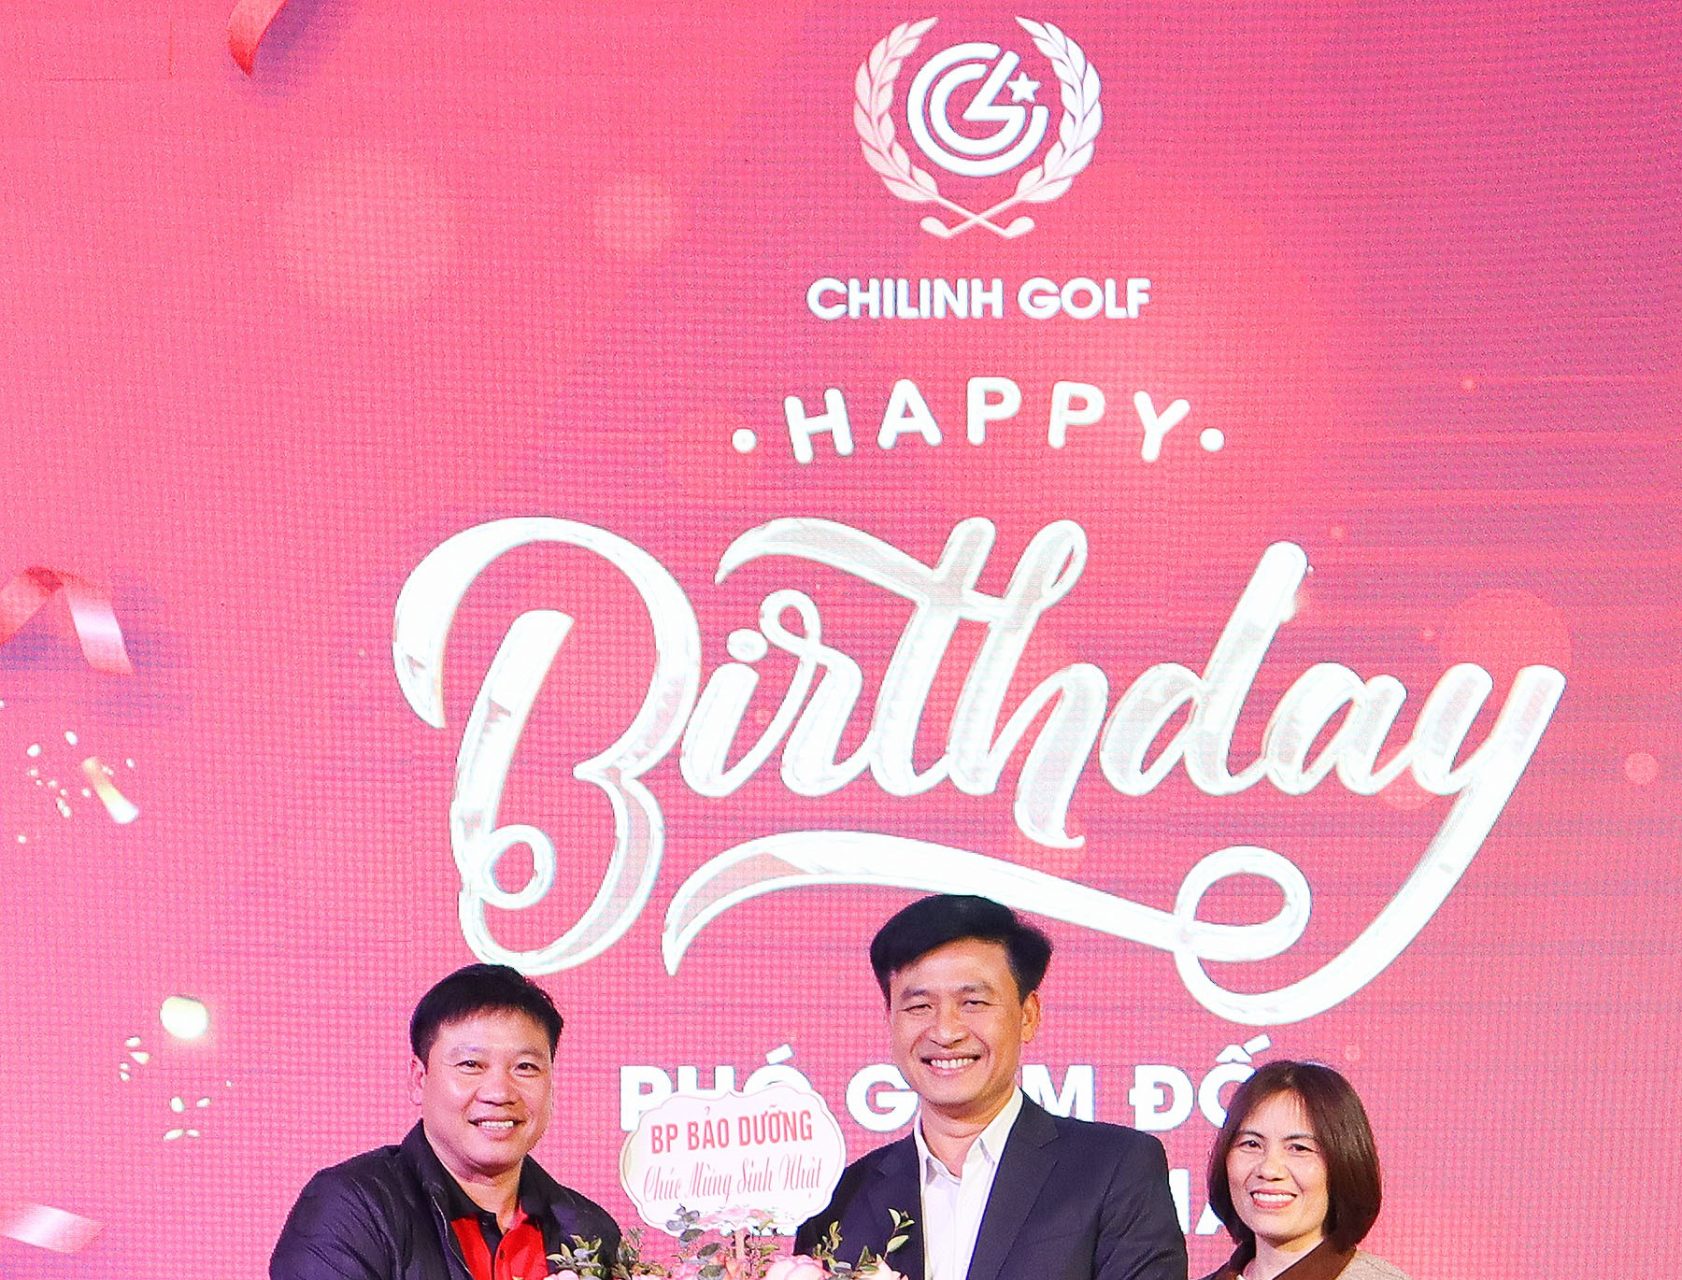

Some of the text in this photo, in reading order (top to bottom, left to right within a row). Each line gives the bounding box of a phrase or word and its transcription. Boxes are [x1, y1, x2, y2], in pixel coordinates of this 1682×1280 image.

[806, 276, 1152, 320] CHILINH GOLF
[783, 376, 1191, 464] HAPPY
[393, 516, 1566, 1026] Birthday
[845, 1063, 1096, 1132] GM
[1128, 1034, 1272, 1132] ĐỐ
[651, 1104, 813, 1154] BP BẢO DƯỠNG
